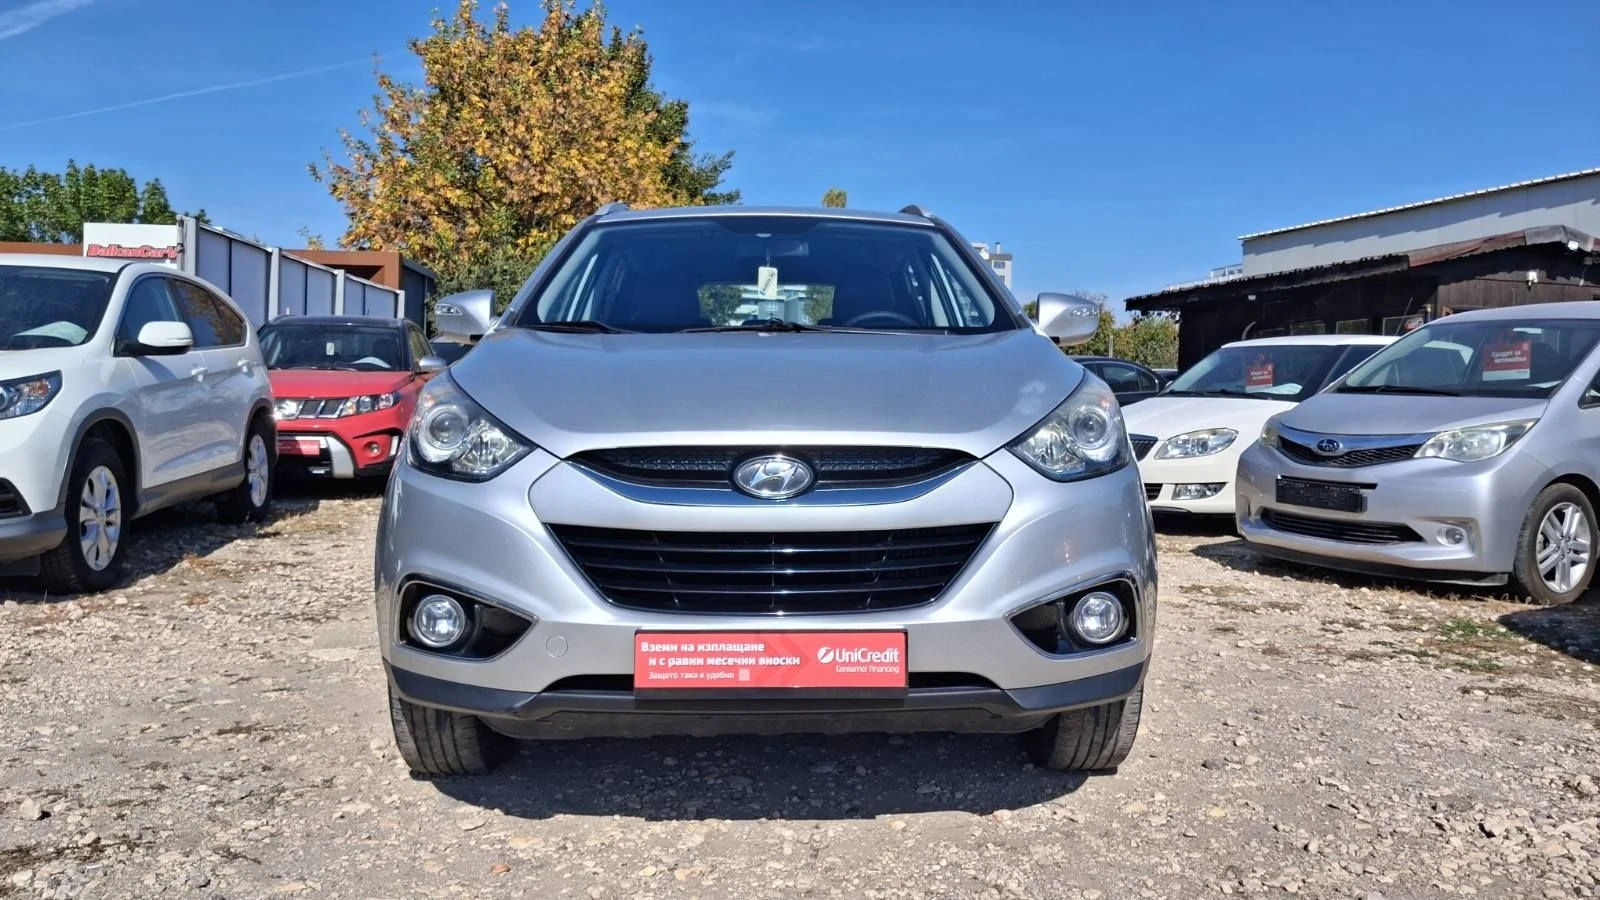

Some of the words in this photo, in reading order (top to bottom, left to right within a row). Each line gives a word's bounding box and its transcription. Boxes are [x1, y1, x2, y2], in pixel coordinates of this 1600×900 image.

[641, 641, 678, 652] Вземи
[680, 643, 695, 652] на
[697, 643, 765, 653] изплащане
[835, 647, 899, 663] UniCredit
[648, 657, 656, 666] и
[659, 657, 666, 666] с
[668, 657, 704, 668] равни
[706, 657, 756, 666] месечни
[758, 656, 801, 666] вноски
[648, 671, 679, 680] Защото
[706, 670, 735, 680] удобно
[836, 665, 868, 673] Consumer
[869, 665, 900, 674] Financing
